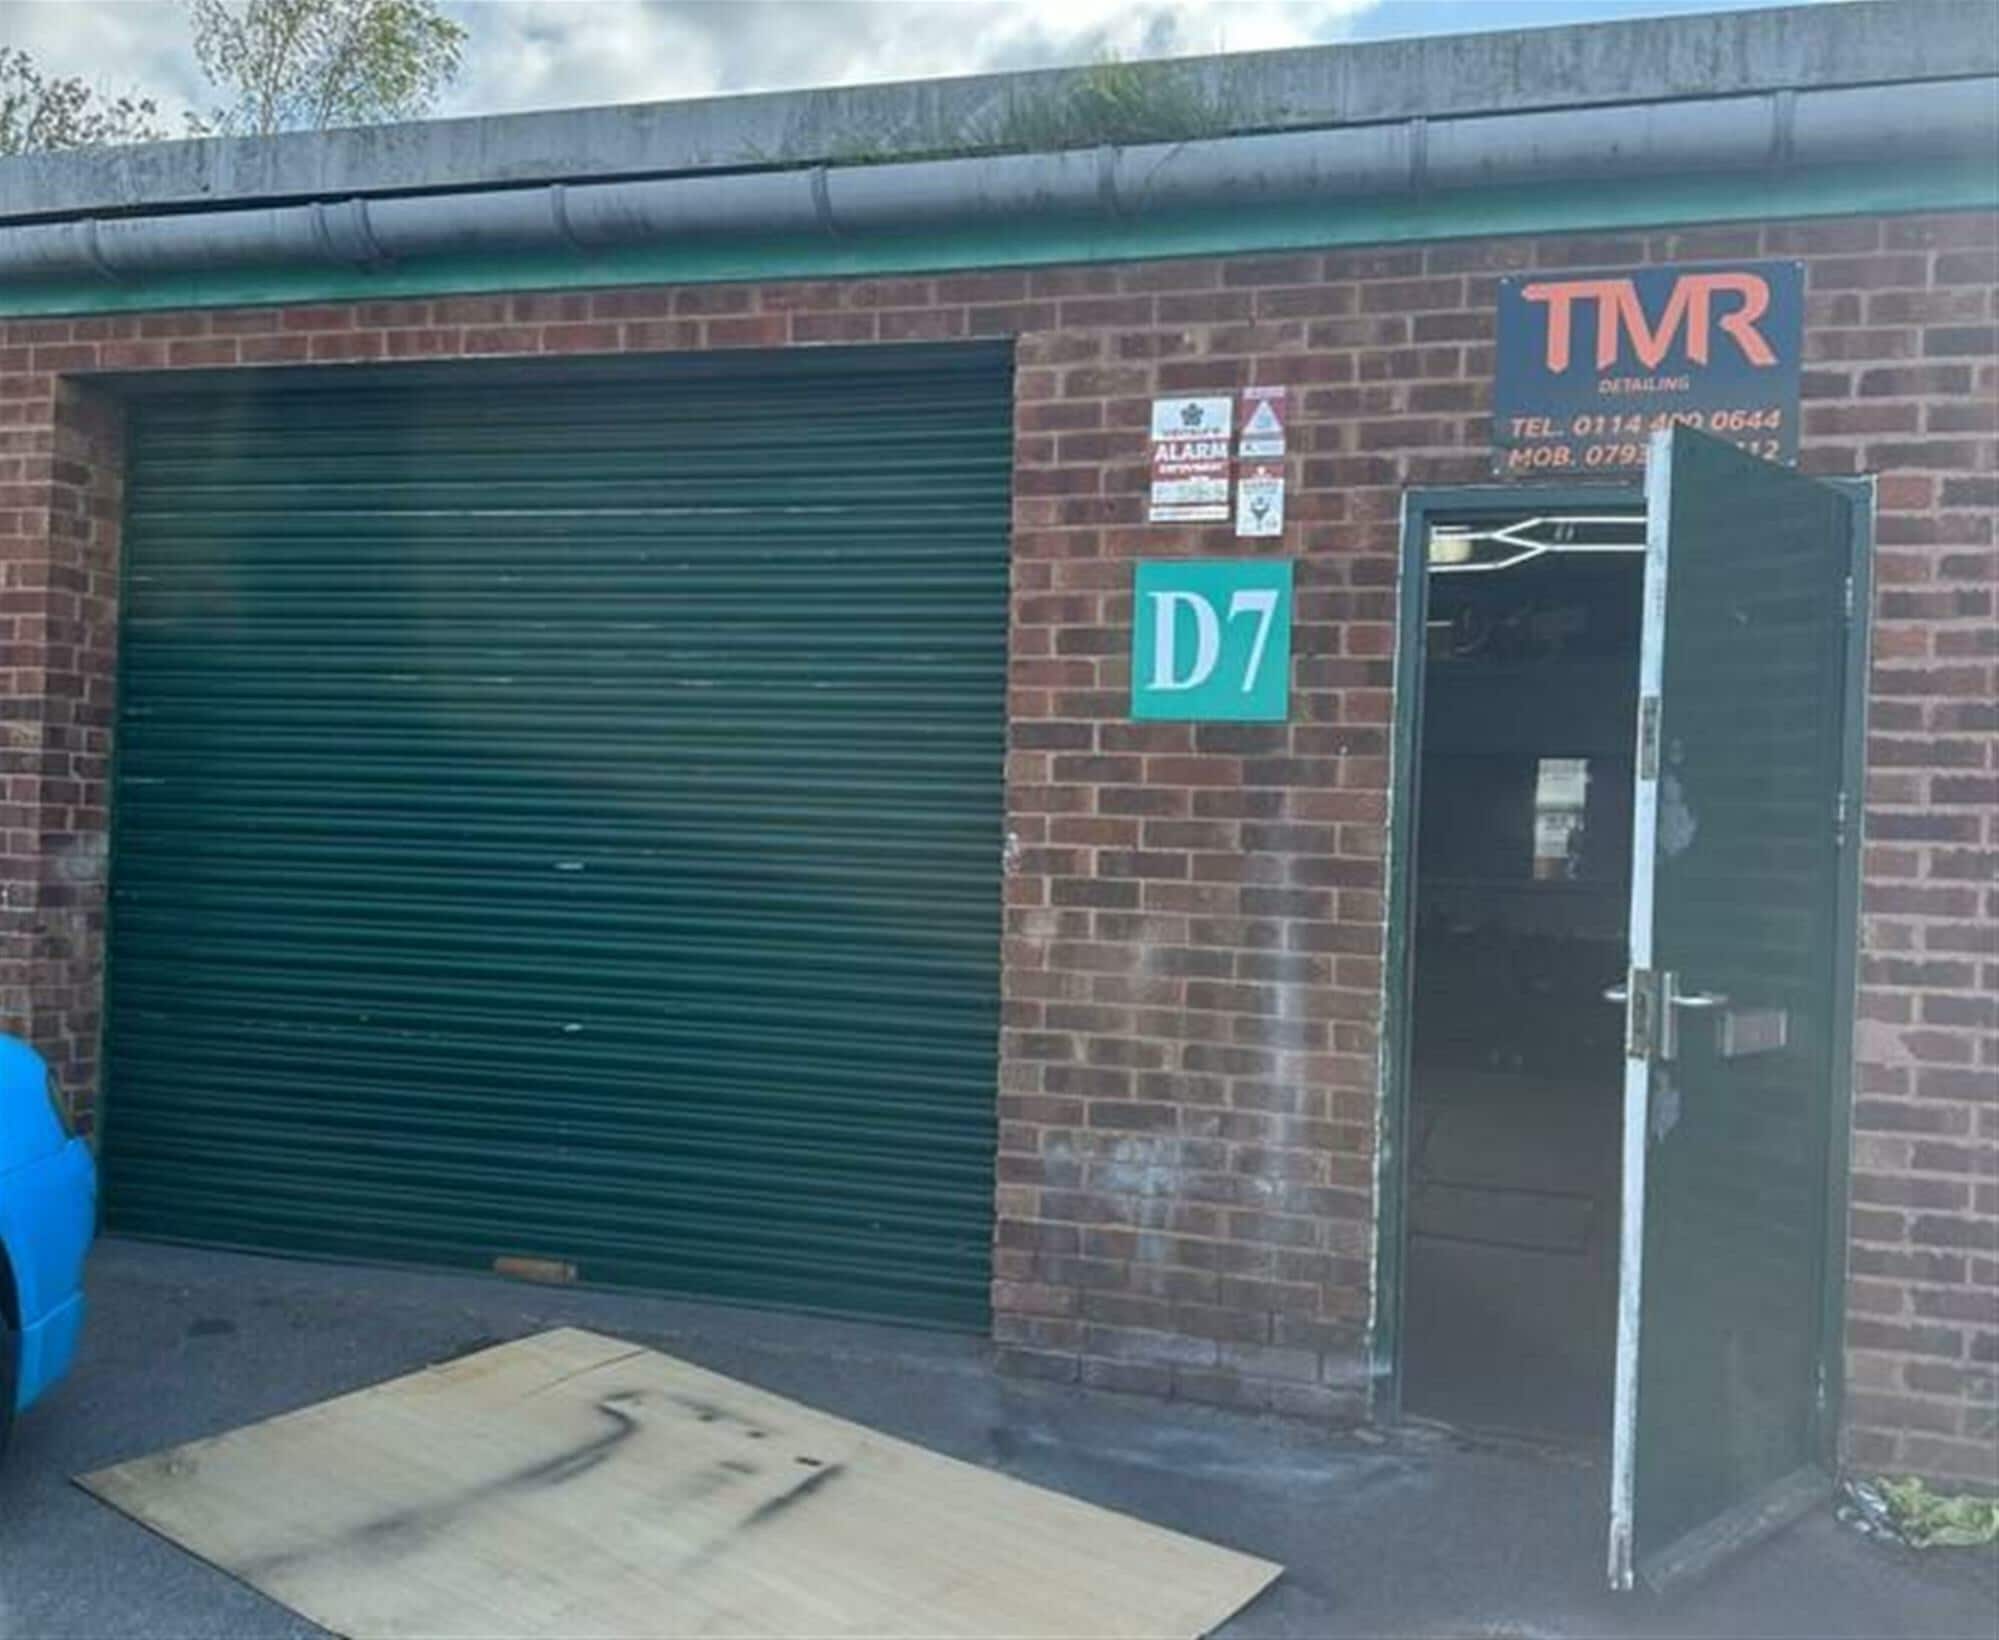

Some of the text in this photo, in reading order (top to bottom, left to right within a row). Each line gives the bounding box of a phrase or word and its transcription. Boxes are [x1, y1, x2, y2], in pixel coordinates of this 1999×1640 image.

[1521, 272, 1779, 374] TMR
[1598, 375, 1690, 394] DETAILING
[1511, 416, 1564, 438] TEL.
[1573, 413, 1642, 437] 0114
[1711, 408, 1781, 430] 0644
[1153, 441, 1229, 463] ALARM
[1508, 444, 1576, 468] MOB.
[1145, 588, 1280, 693] D7
